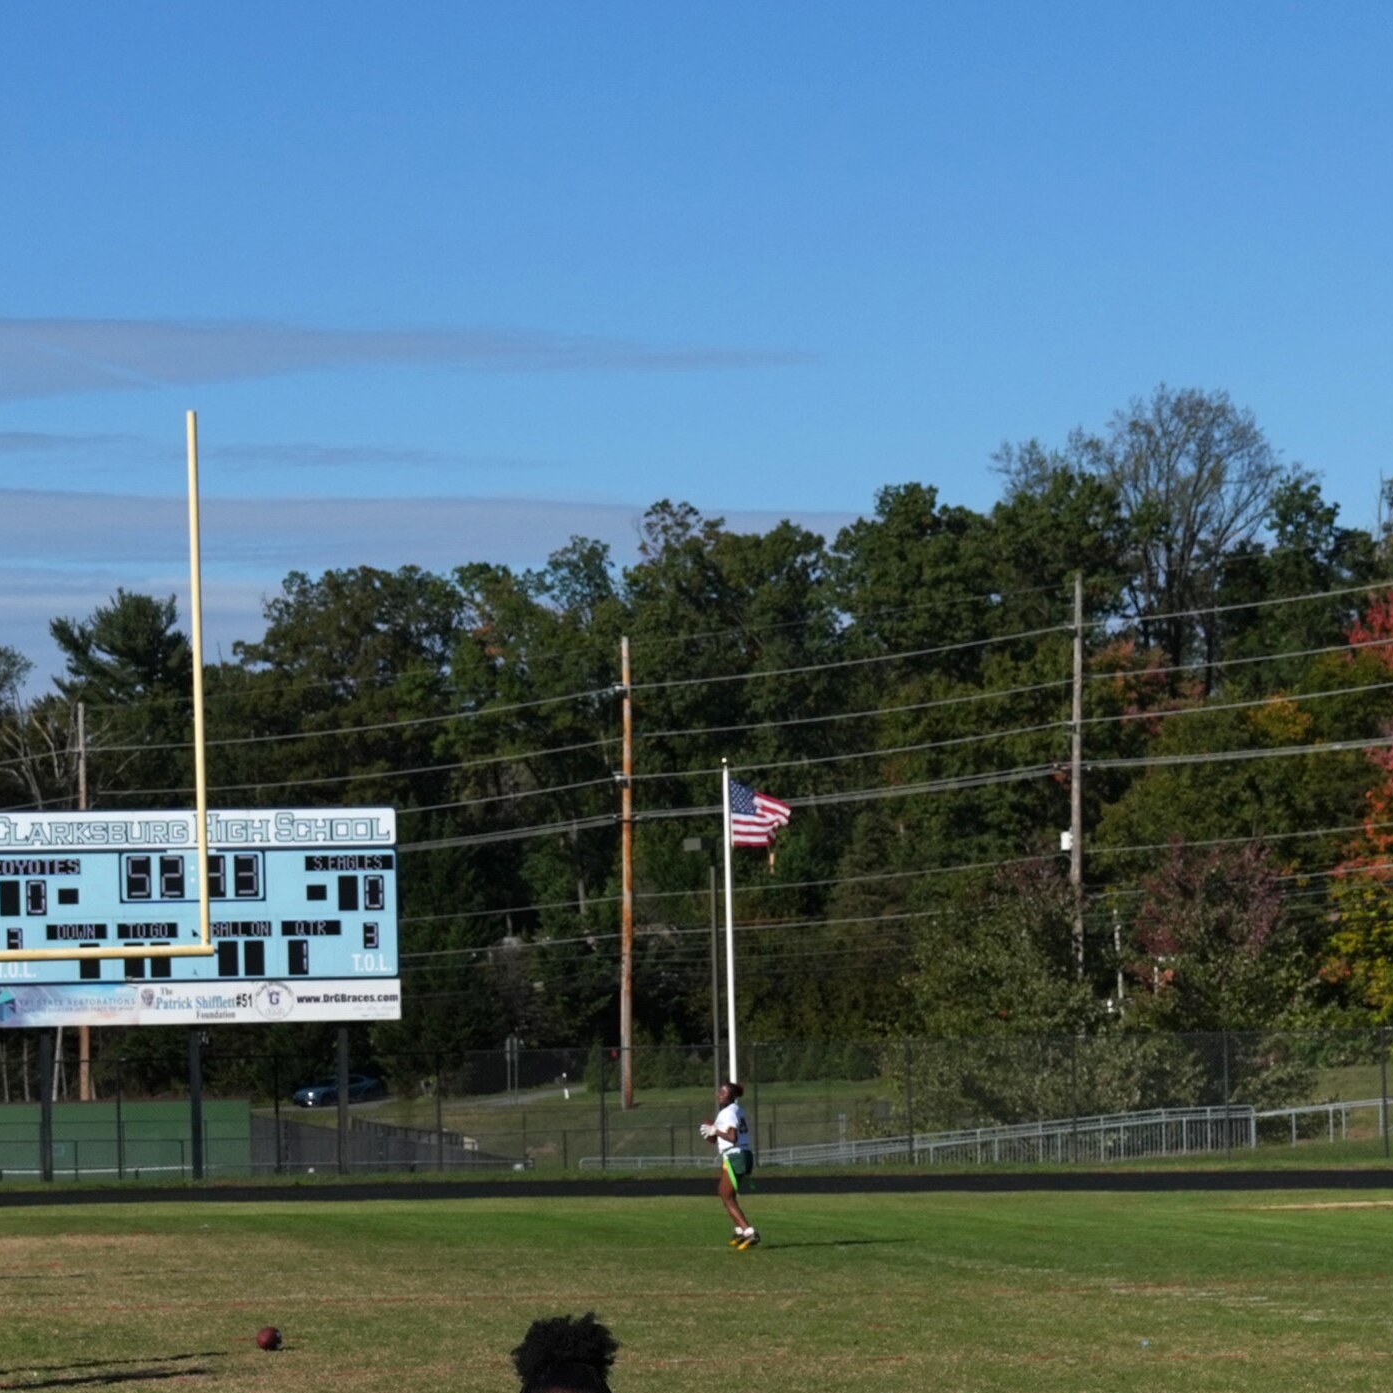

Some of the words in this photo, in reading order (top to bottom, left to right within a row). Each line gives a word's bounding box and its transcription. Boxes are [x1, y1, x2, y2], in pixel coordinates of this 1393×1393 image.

[193, 813, 271, 843] HIGH
[275, 812, 390, 842] SCHOOL
[313, 855, 384, 871] S.EAGLES
[27, 880, 46, 914] 0
[365, 876, 383, 909] 0
[56, 924, 96, 939] DOWN
[129, 923, 146, 938] TO
[150, 923, 169, 938] GO
[211, 922, 248, 937] BALL
[250, 921, 271, 936] ON
[294, 920, 327, 936] QTR
[365, 922, 379, 948] 3
[351, 953, 392, 973] T.O.L.
[160, 986, 173, 996] The
[296, 993, 399, 1004] www.DrGBraces.com
[155, 996, 193, 1010] Patrick
[236, 993, 253, 1008] #51
[196, 1010, 236, 1019] Foundation
